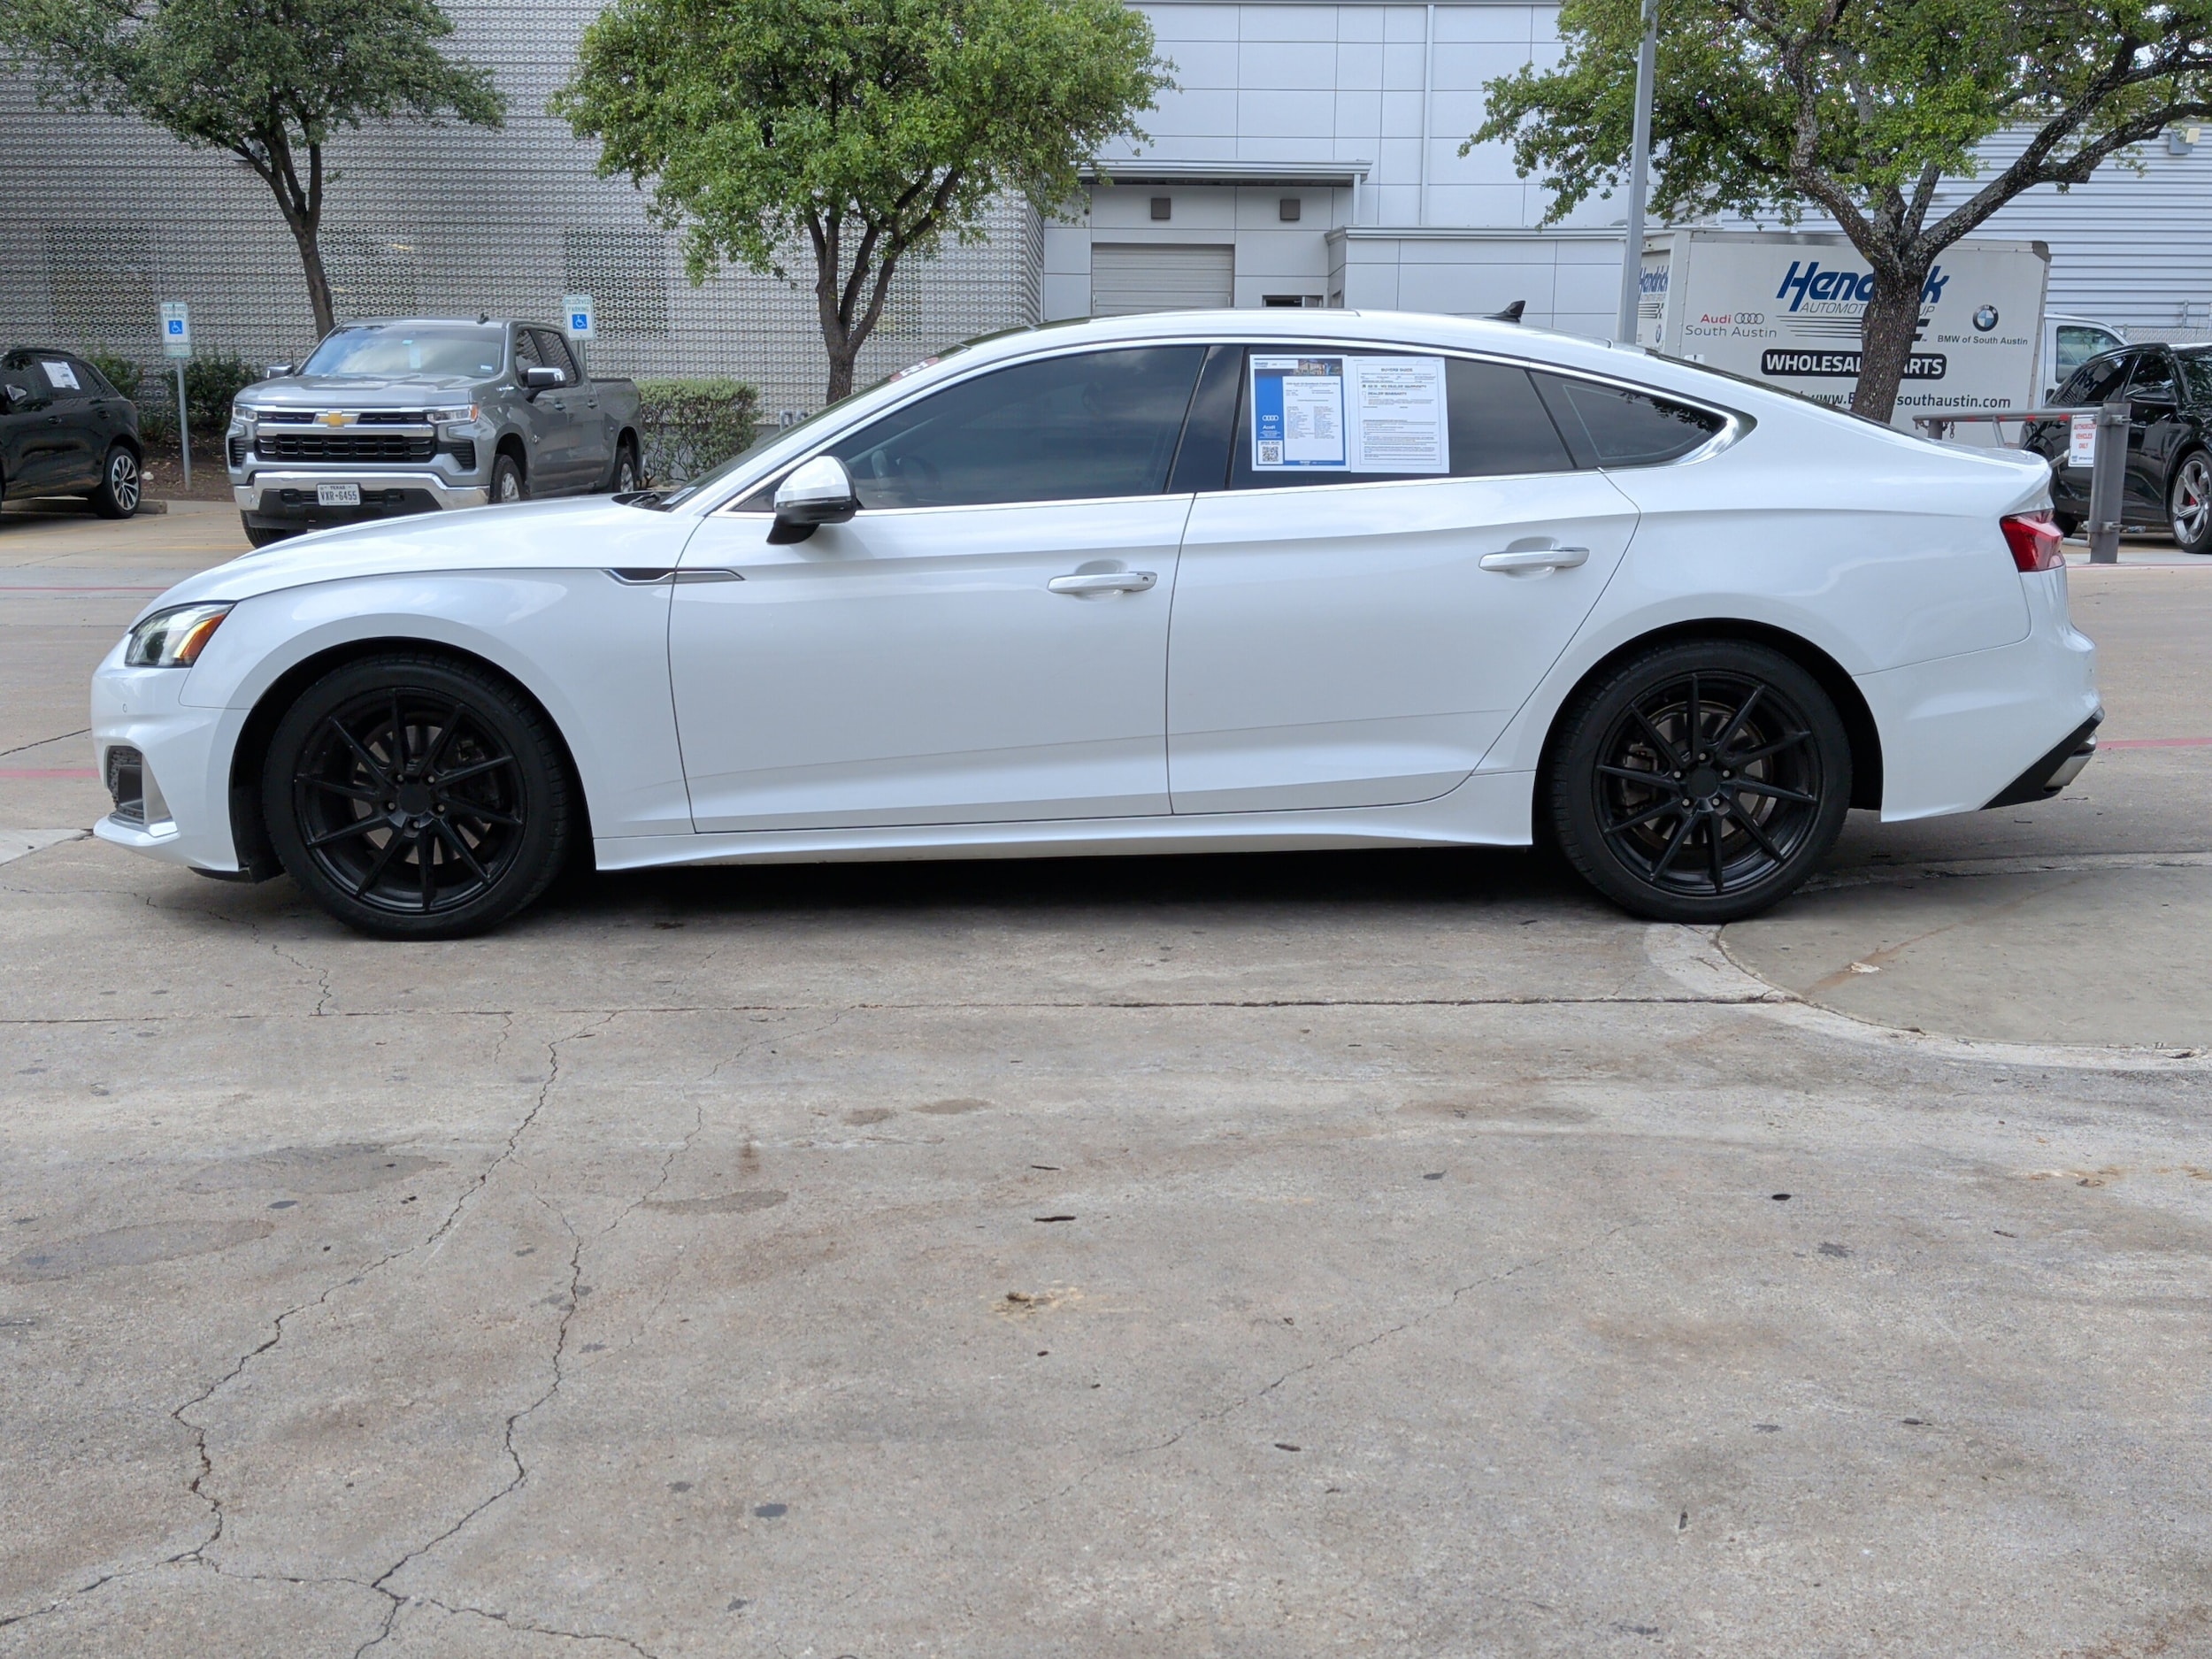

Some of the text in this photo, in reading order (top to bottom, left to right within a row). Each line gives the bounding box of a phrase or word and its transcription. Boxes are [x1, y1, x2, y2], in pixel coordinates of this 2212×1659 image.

[1776, 261, 1950, 311] Henk
[1800, 302, 1867, 314] AUTOMOT
[1701, 313, 1732, 324] Audi
[1685, 325, 1778, 338] South Austin
[1937, 334, 1961, 343] BMW
[1972, 335, 1998, 344] South
[2000, 336, 2028, 345] Austin
[1766, 354, 1943, 376] WHOLESAL ARTS
